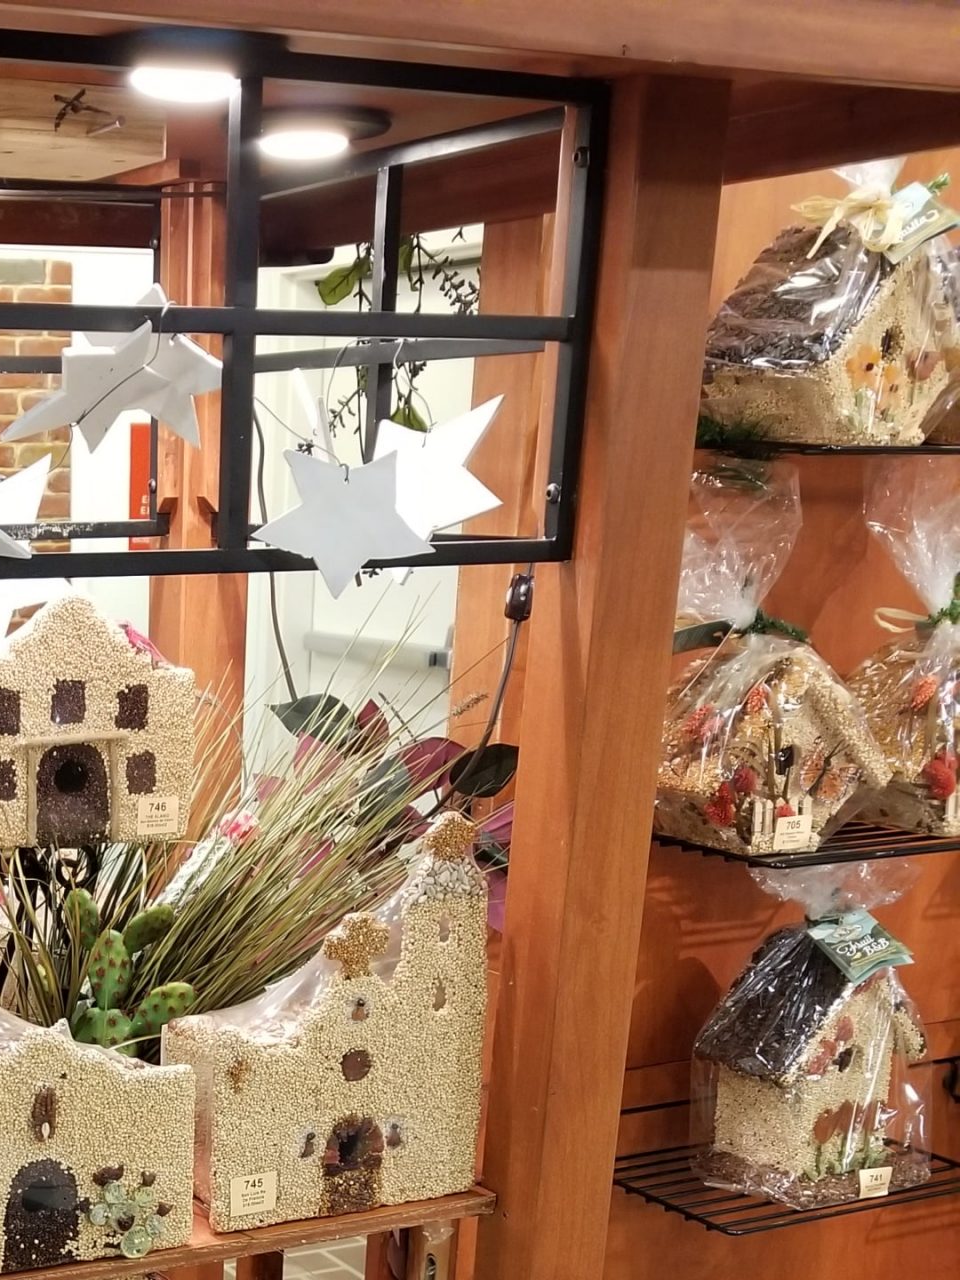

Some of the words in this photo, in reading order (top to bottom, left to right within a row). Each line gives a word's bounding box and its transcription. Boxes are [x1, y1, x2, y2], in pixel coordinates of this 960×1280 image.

[149, 802, 167, 812] 746
[787, 820, 801, 830] 705
[863, 938, 890, 955] B&B
[870, 1174, 883, 1182] 741
[244, 1178, 263, 1190] 745
